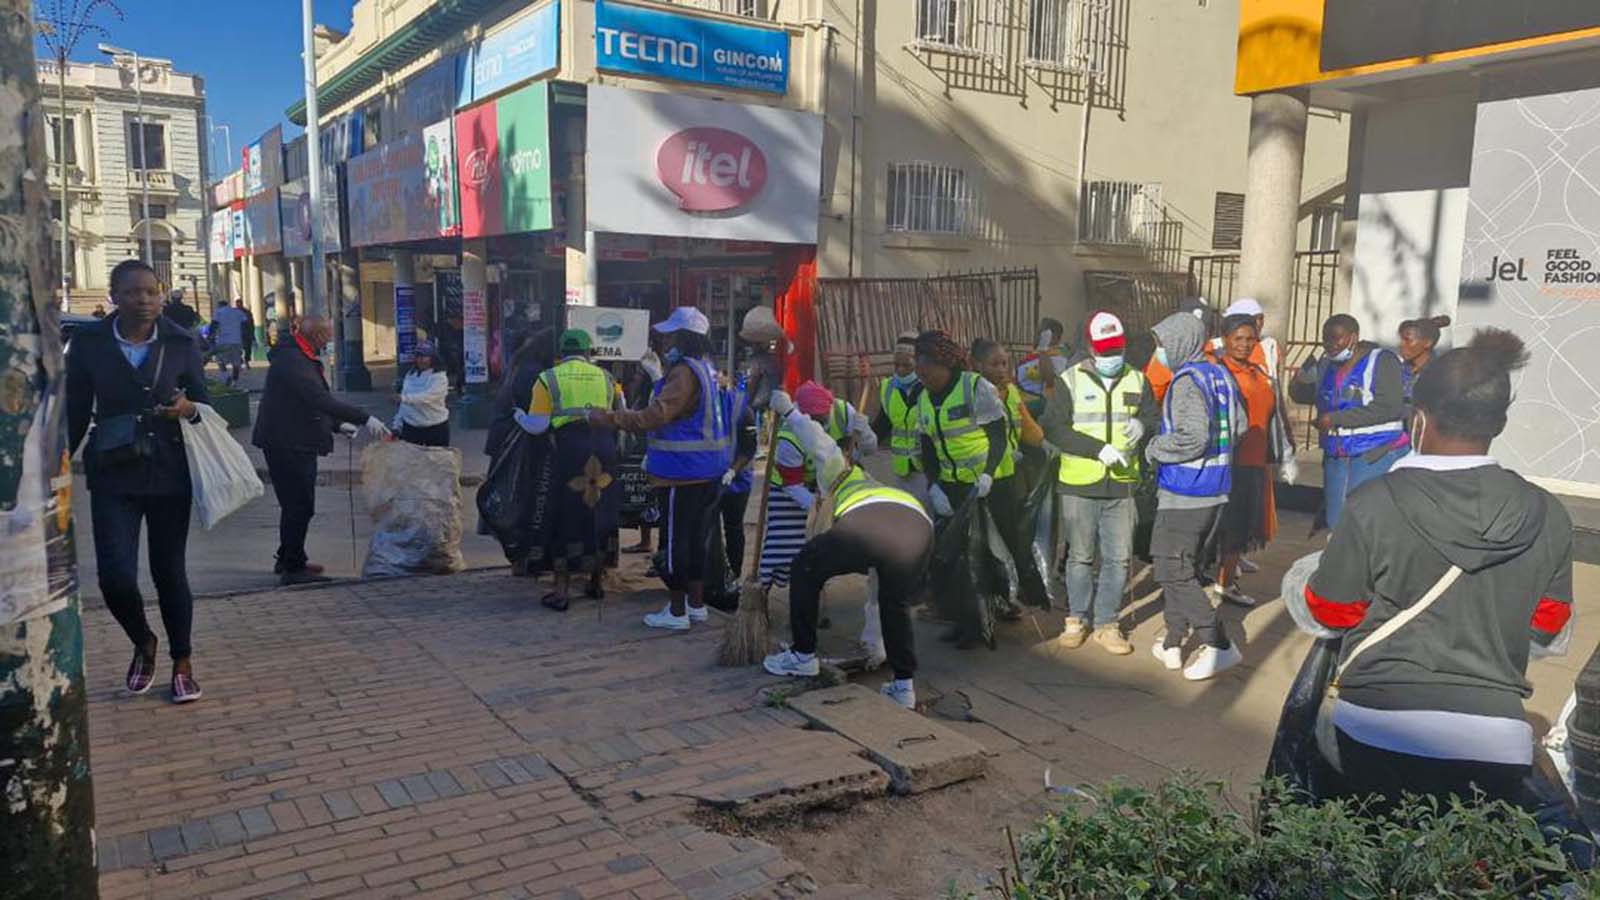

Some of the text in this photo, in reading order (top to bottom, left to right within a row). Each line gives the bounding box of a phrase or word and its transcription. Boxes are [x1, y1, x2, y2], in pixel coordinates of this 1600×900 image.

[597, 27, 698, 68] TECNO
[713, 48, 783, 73] GINCOM
[681, 141, 752, 188] itel
[1545, 260, 1591, 271] GOOD
[1547, 249, 1580, 259] FEEL
